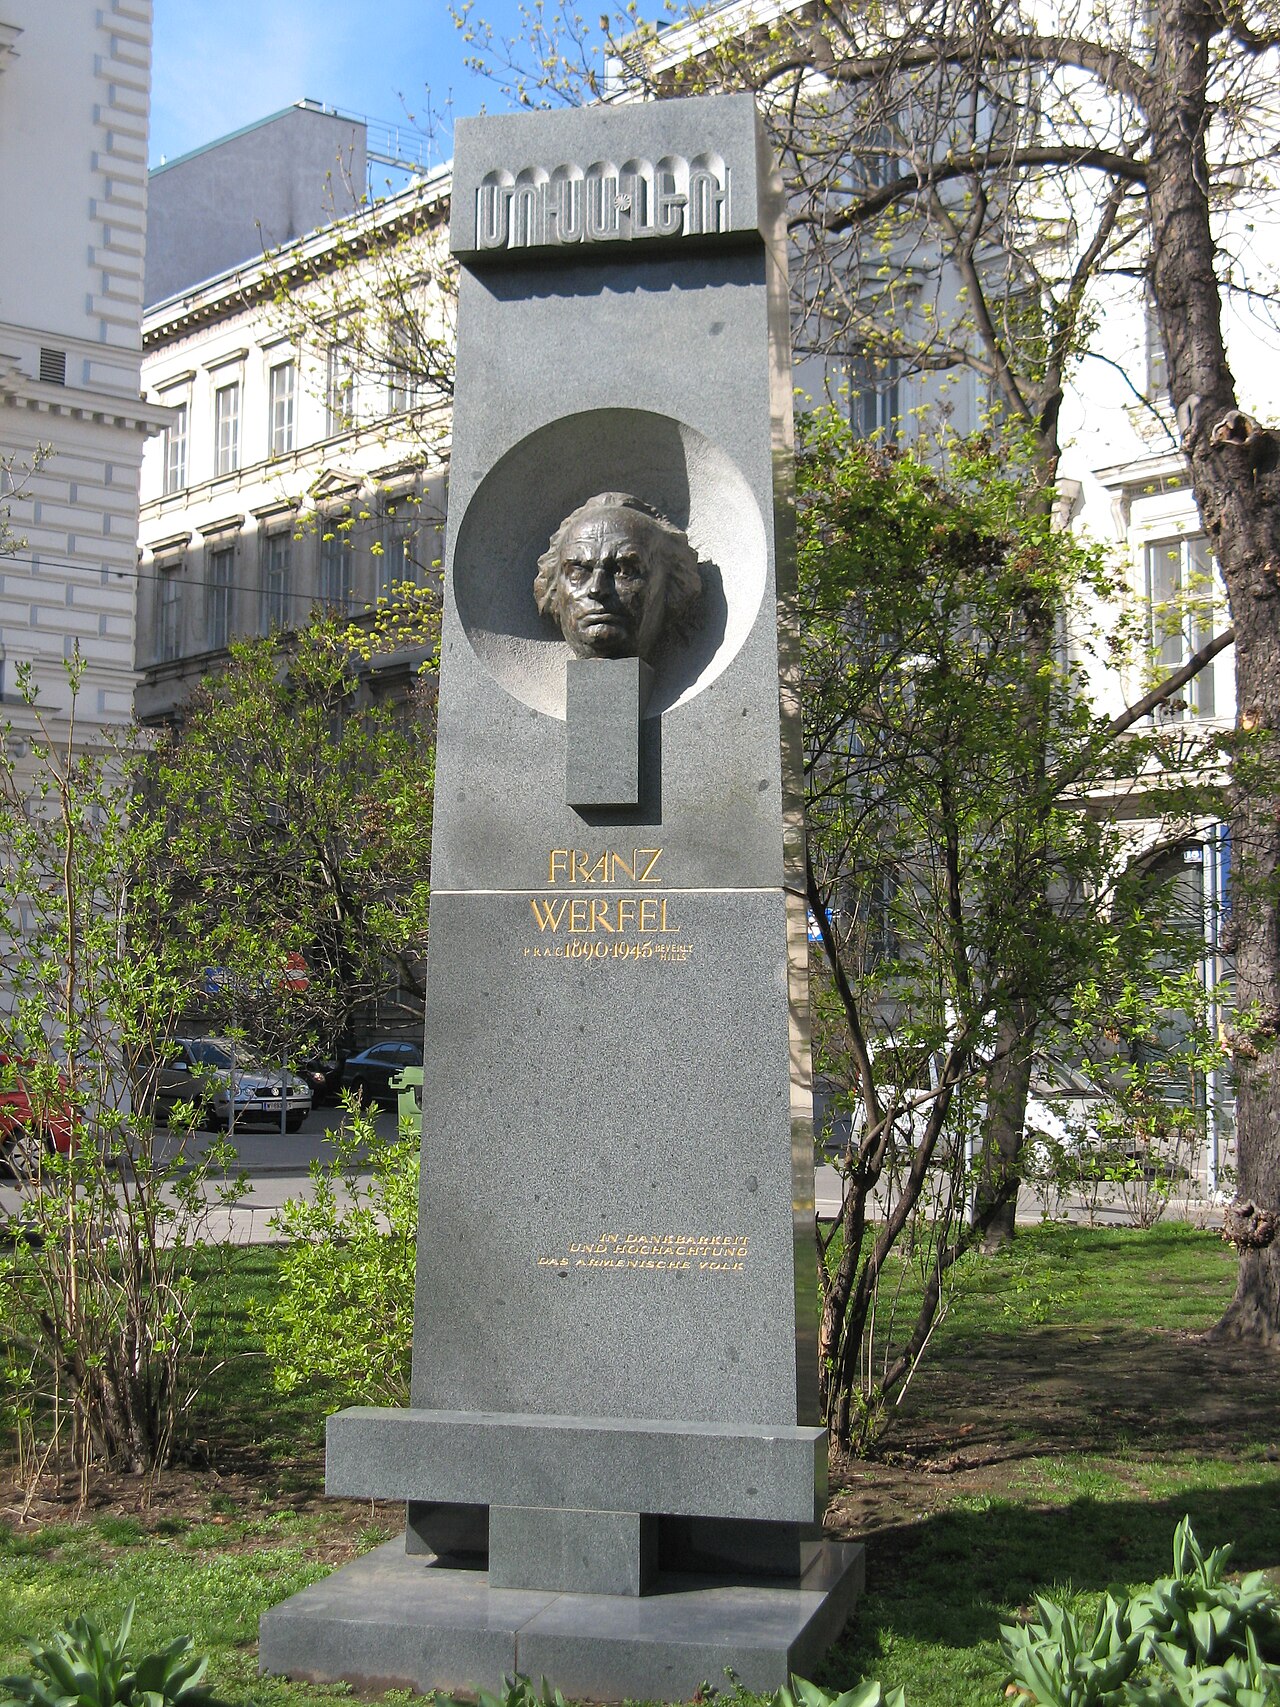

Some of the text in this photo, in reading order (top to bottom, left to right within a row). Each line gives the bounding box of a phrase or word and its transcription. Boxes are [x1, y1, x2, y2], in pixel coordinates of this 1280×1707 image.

[547, 848, 663, 883] FRANZ
[529, 898, 681, 933] WERFEL
[523, 946, 563, 957] PRAG
[655, 943, 694, 953] BEVERLY
[660, 952, 687, 961] HILLS
[599, 1233, 750, 1246] IN DANKBARKEIT
[569, 1243, 608, 1253] UND
[537, 1257, 744, 1270] DAS ARMENISCHE VOLK
